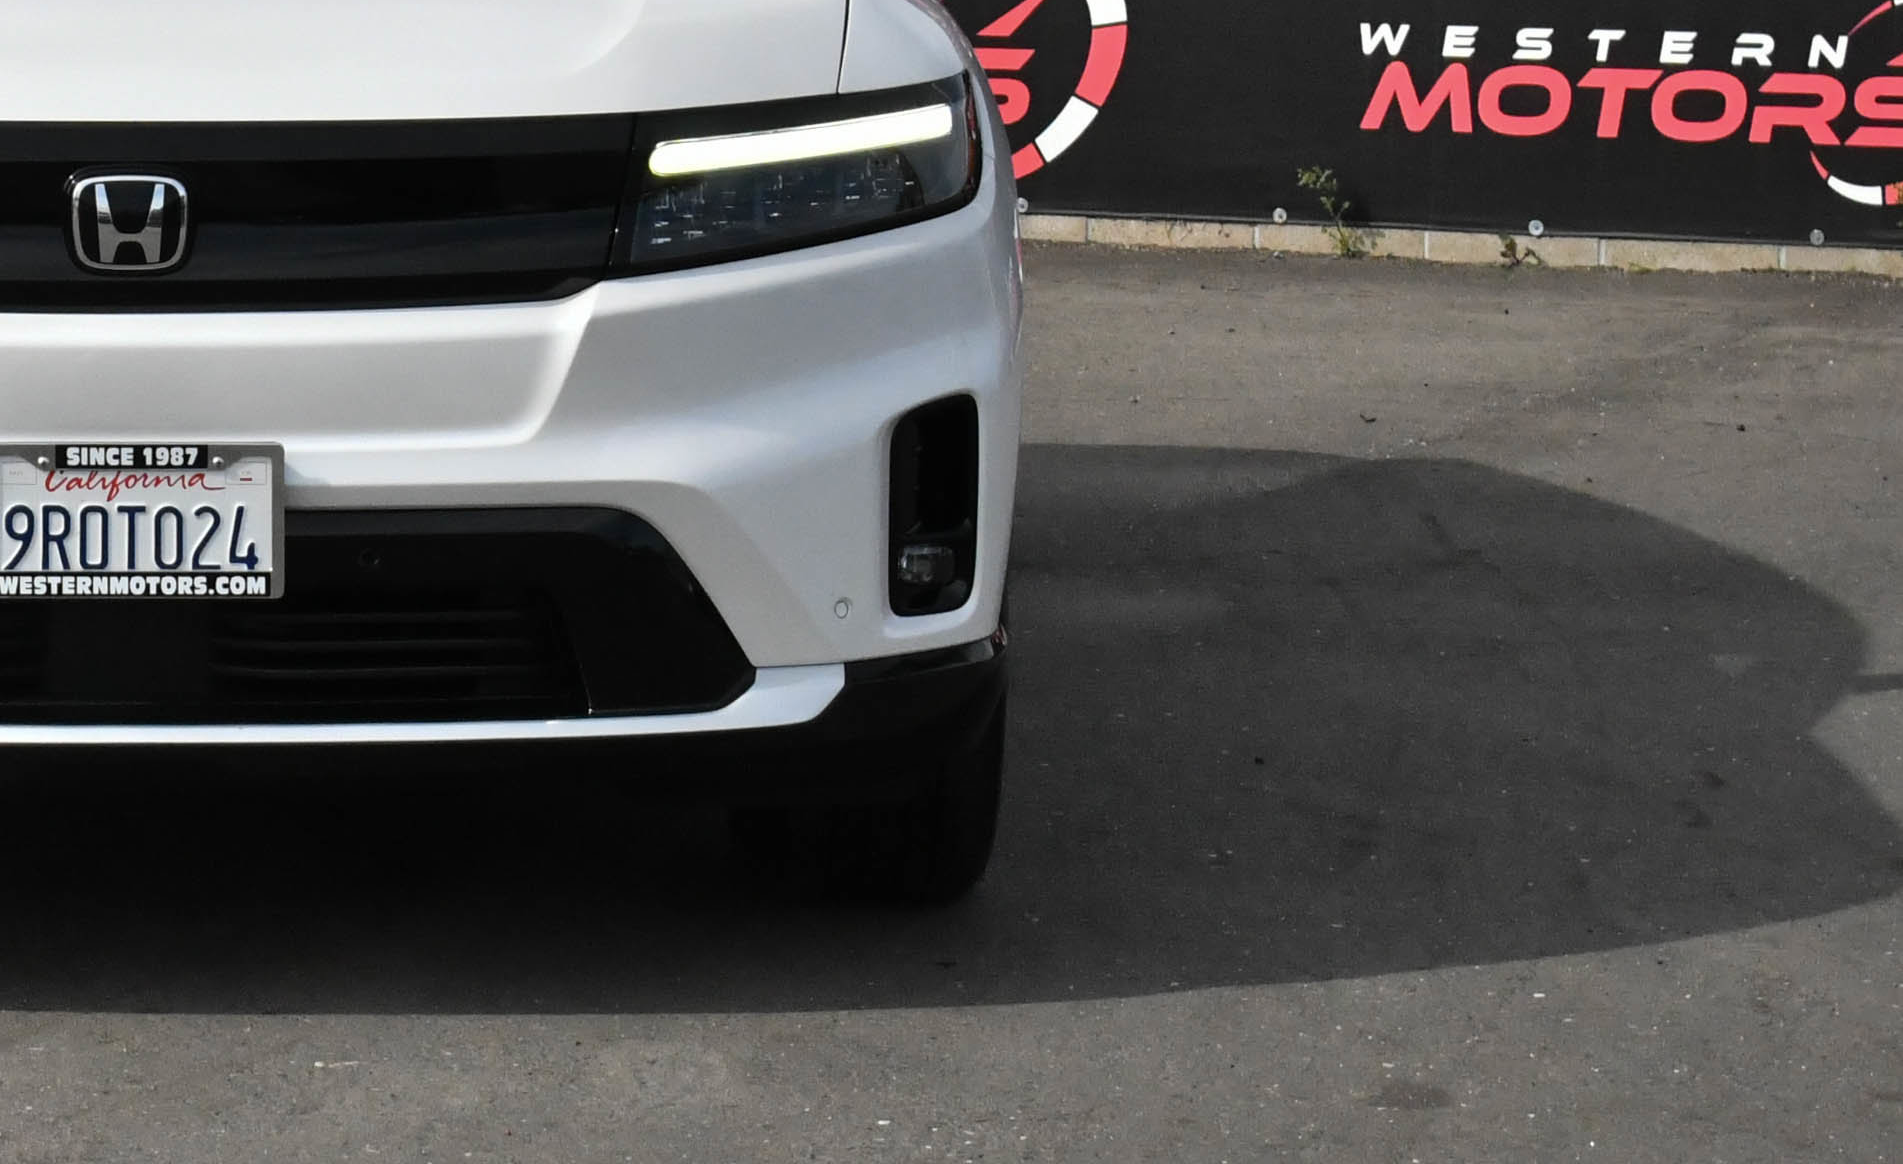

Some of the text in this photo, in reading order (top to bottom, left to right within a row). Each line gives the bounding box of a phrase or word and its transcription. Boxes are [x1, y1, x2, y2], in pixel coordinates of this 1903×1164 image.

[1359, 23, 1849, 69] WESTERN
[1359, 60, 1903, 148] MOTORS
[65, 446, 199, 466] SINCE 1987
[45, 469, 227, 502] California
[3, 504, 260, 570] 9ROT024
